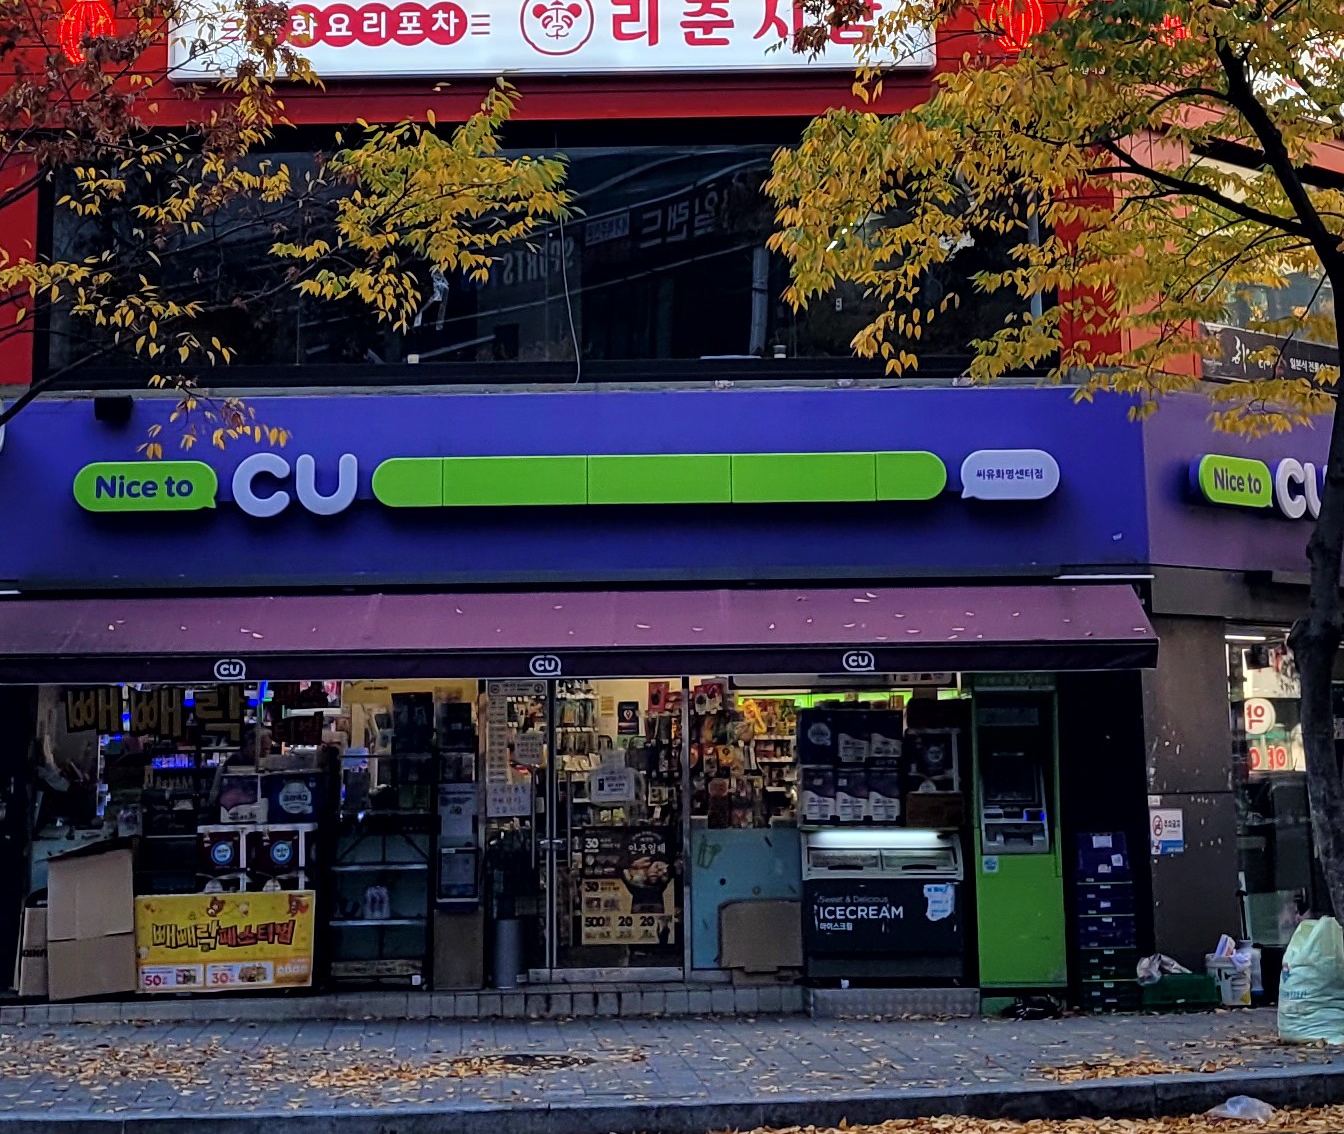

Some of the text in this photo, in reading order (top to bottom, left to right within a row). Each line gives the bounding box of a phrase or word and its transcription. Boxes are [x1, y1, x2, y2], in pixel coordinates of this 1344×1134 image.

[258, 8, 462, 39] 화요리포차
[974, 466, 1044, 481] 씨유화명센터점
[1213, 466, 1241, 492] Nice
[1244, 474, 1262, 494] to
[95, 452, 358, 518] Nice to CU
[536, 658, 556, 673] CU
[848, 652, 870, 668] CU
[220, 662, 241, 677] CU
[584, 881, 599, 893] 30
[819, 905, 905, 920] ICECREAM
